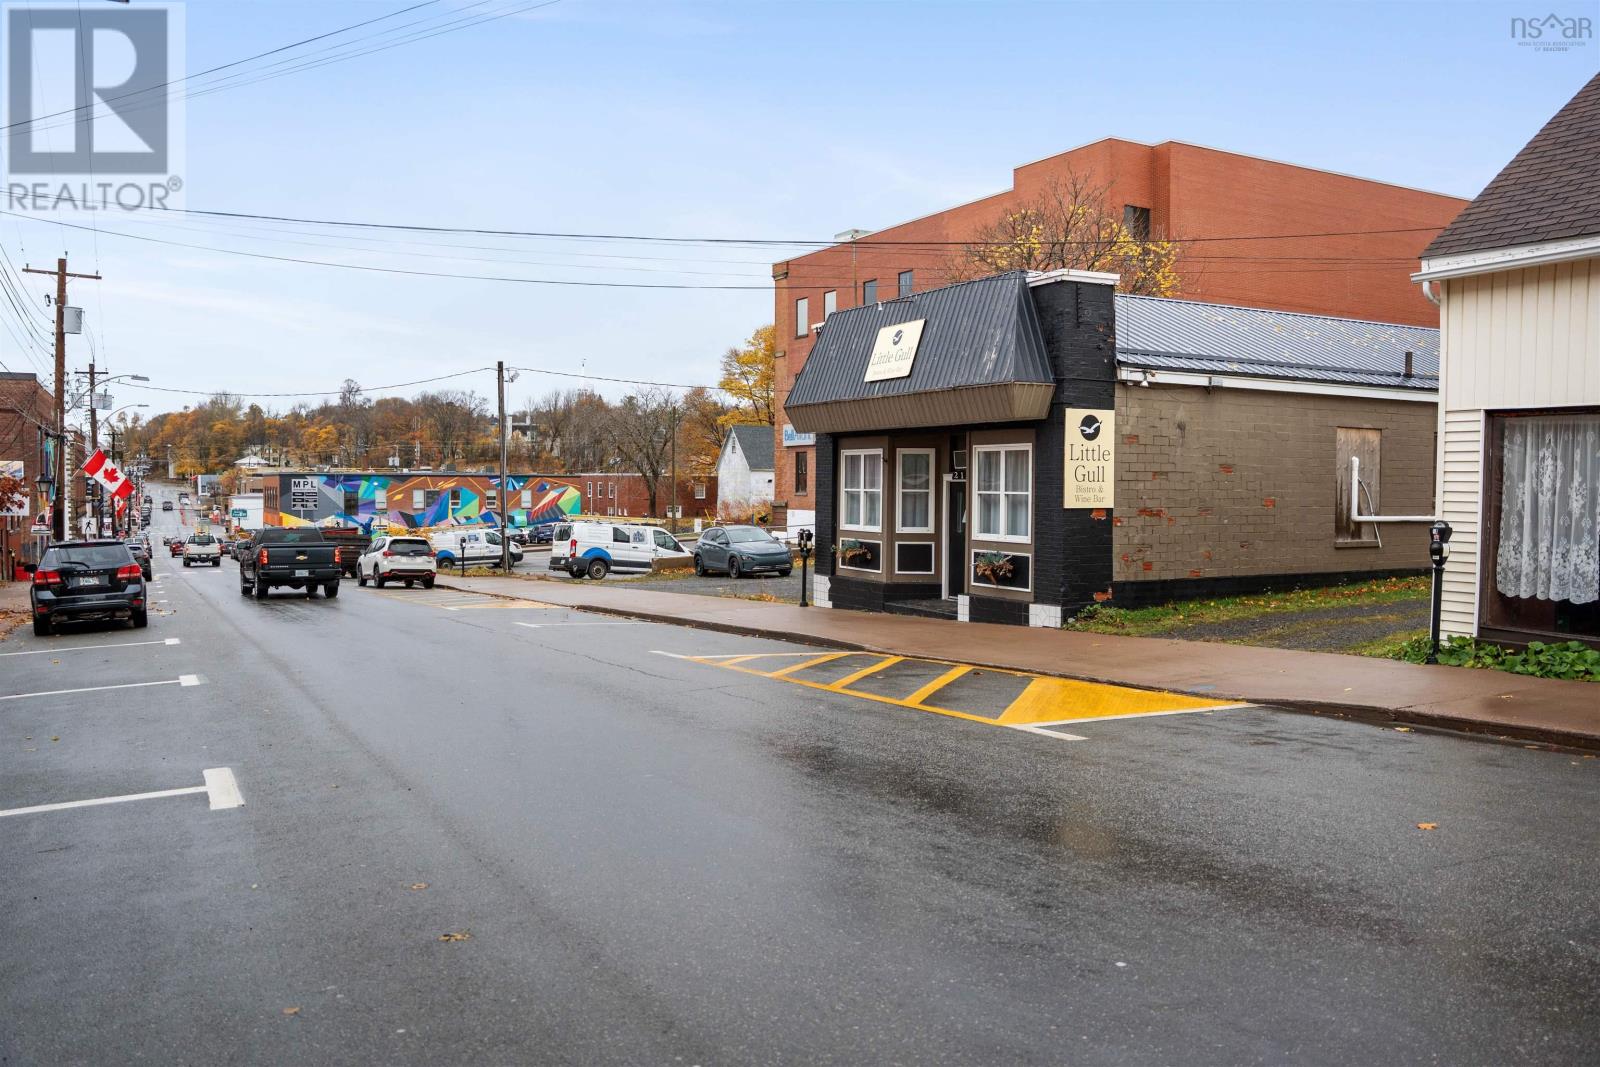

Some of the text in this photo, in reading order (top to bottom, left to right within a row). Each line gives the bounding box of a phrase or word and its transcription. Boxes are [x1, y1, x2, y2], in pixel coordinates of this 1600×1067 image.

[871, 346, 914, 366] Little Gull
[1069, 443, 1111, 462] Little
[1074, 465, 1105, 483] Gull
[293, 480, 317, 489] MPL
[1076, 484, 1104, 494] Bistro &
[1074, 494, 1105, 503] Wine Bar
